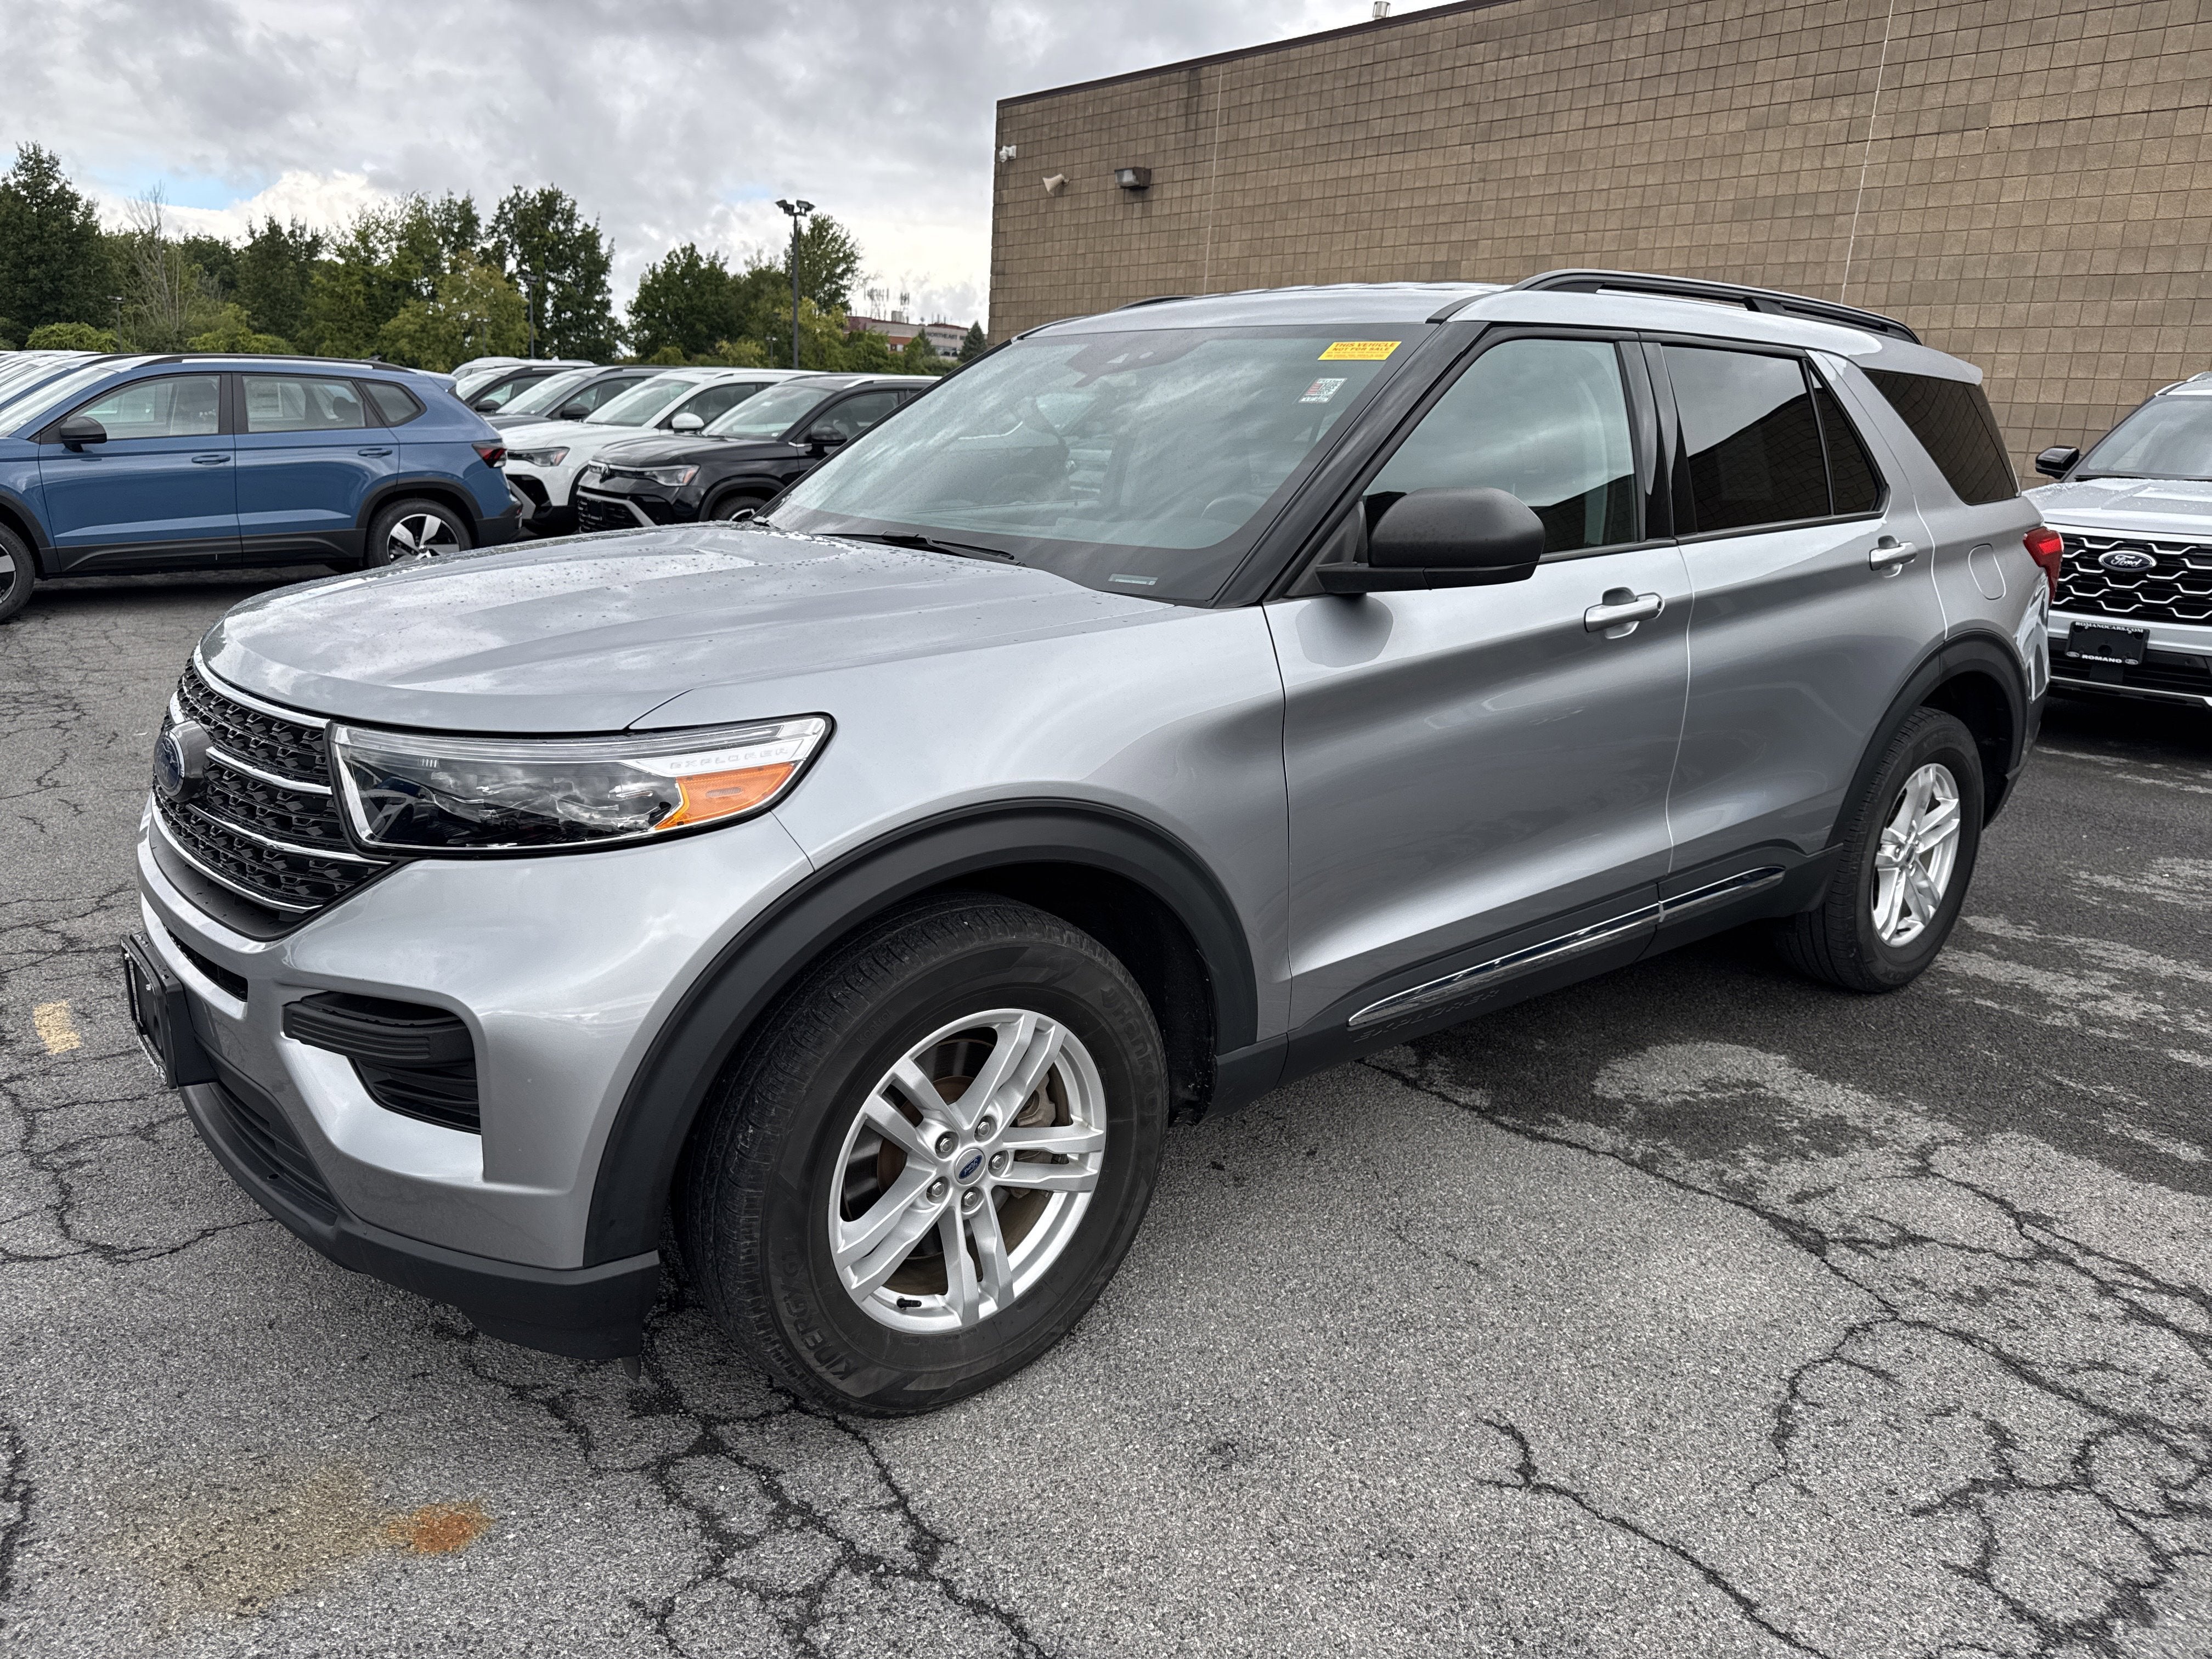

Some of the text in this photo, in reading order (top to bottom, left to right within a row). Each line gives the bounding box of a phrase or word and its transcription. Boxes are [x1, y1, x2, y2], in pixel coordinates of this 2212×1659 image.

[2111, 555, 2143, 568] Ford
[2081, 654, 2123, 663] ROMANO
[669, 747, 788, 770] EXPLORER
[856, 1009, 891, 1046] Kontrol
[1353, 989, 1500, 1043] EXPLORER
[1112, 1003, 1159, 1132] Hankook
[781, 1281, 859, 1381] KINERGY
